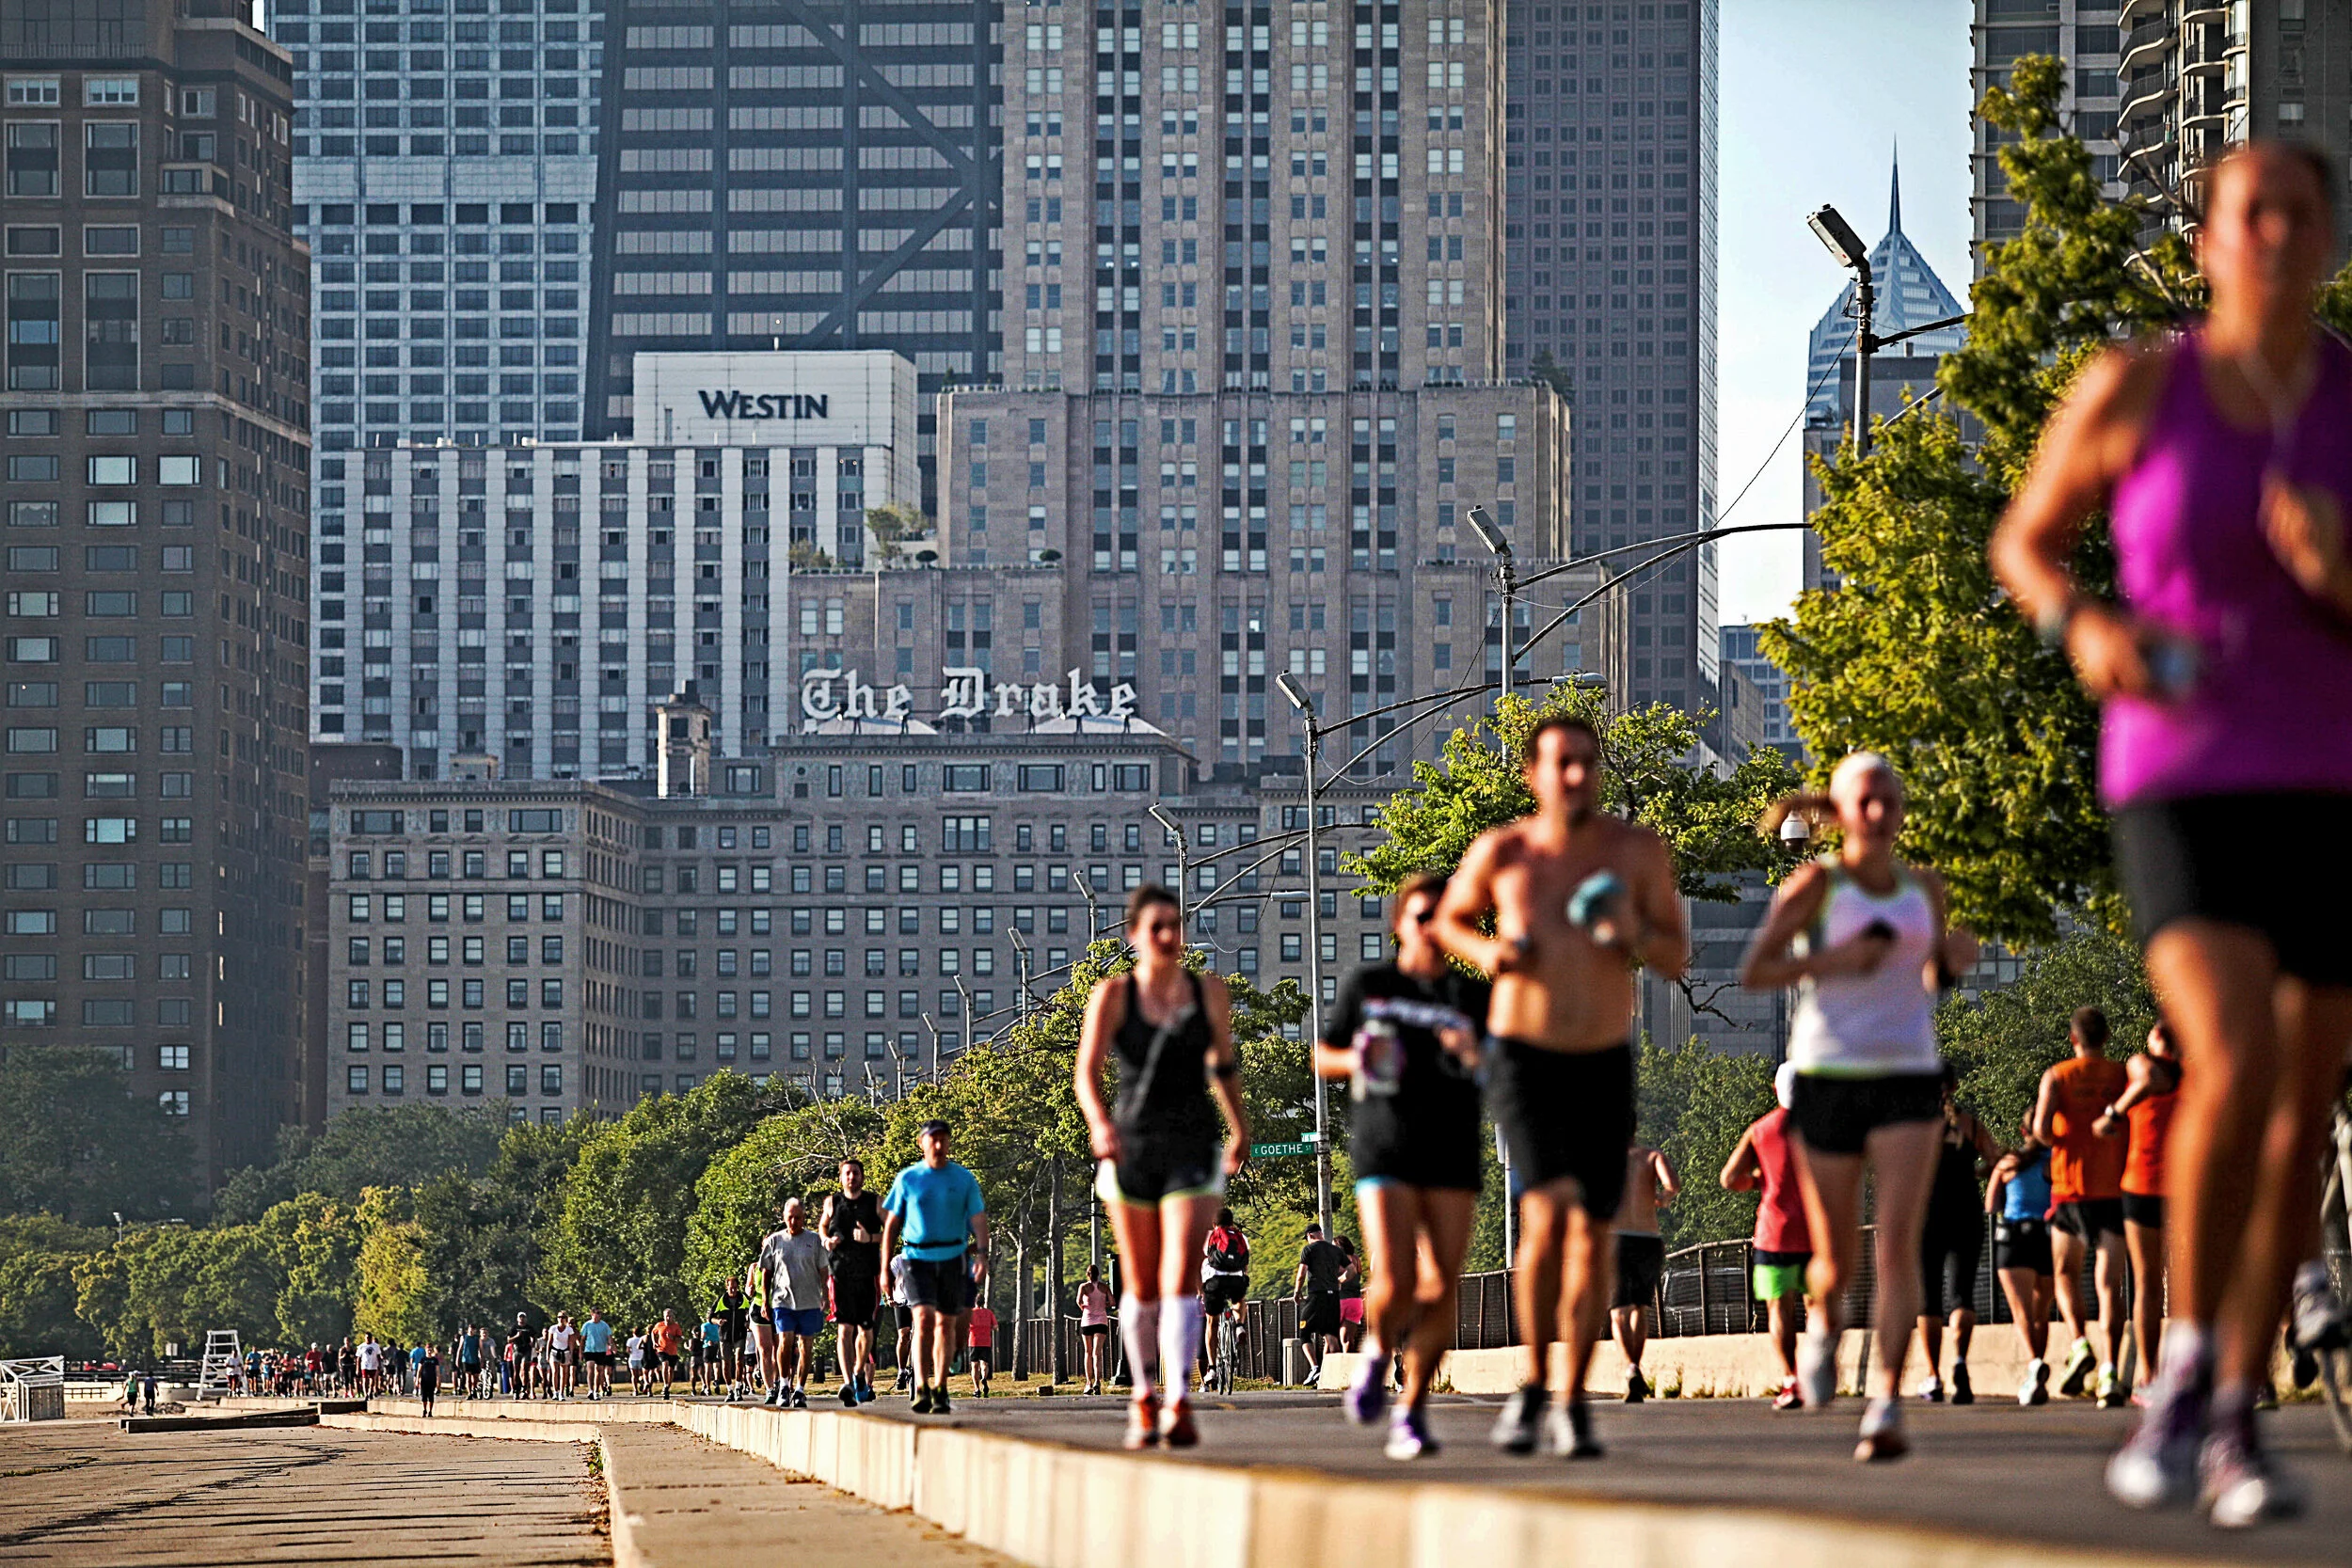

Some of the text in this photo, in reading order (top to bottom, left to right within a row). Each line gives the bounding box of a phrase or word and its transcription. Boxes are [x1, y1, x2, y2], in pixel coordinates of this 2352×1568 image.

[698, 390, 828, 420] WESTIN
[801, 666, 1138, 720] The Drake
[1261, 1143, 1304, 1155] GOETHE
